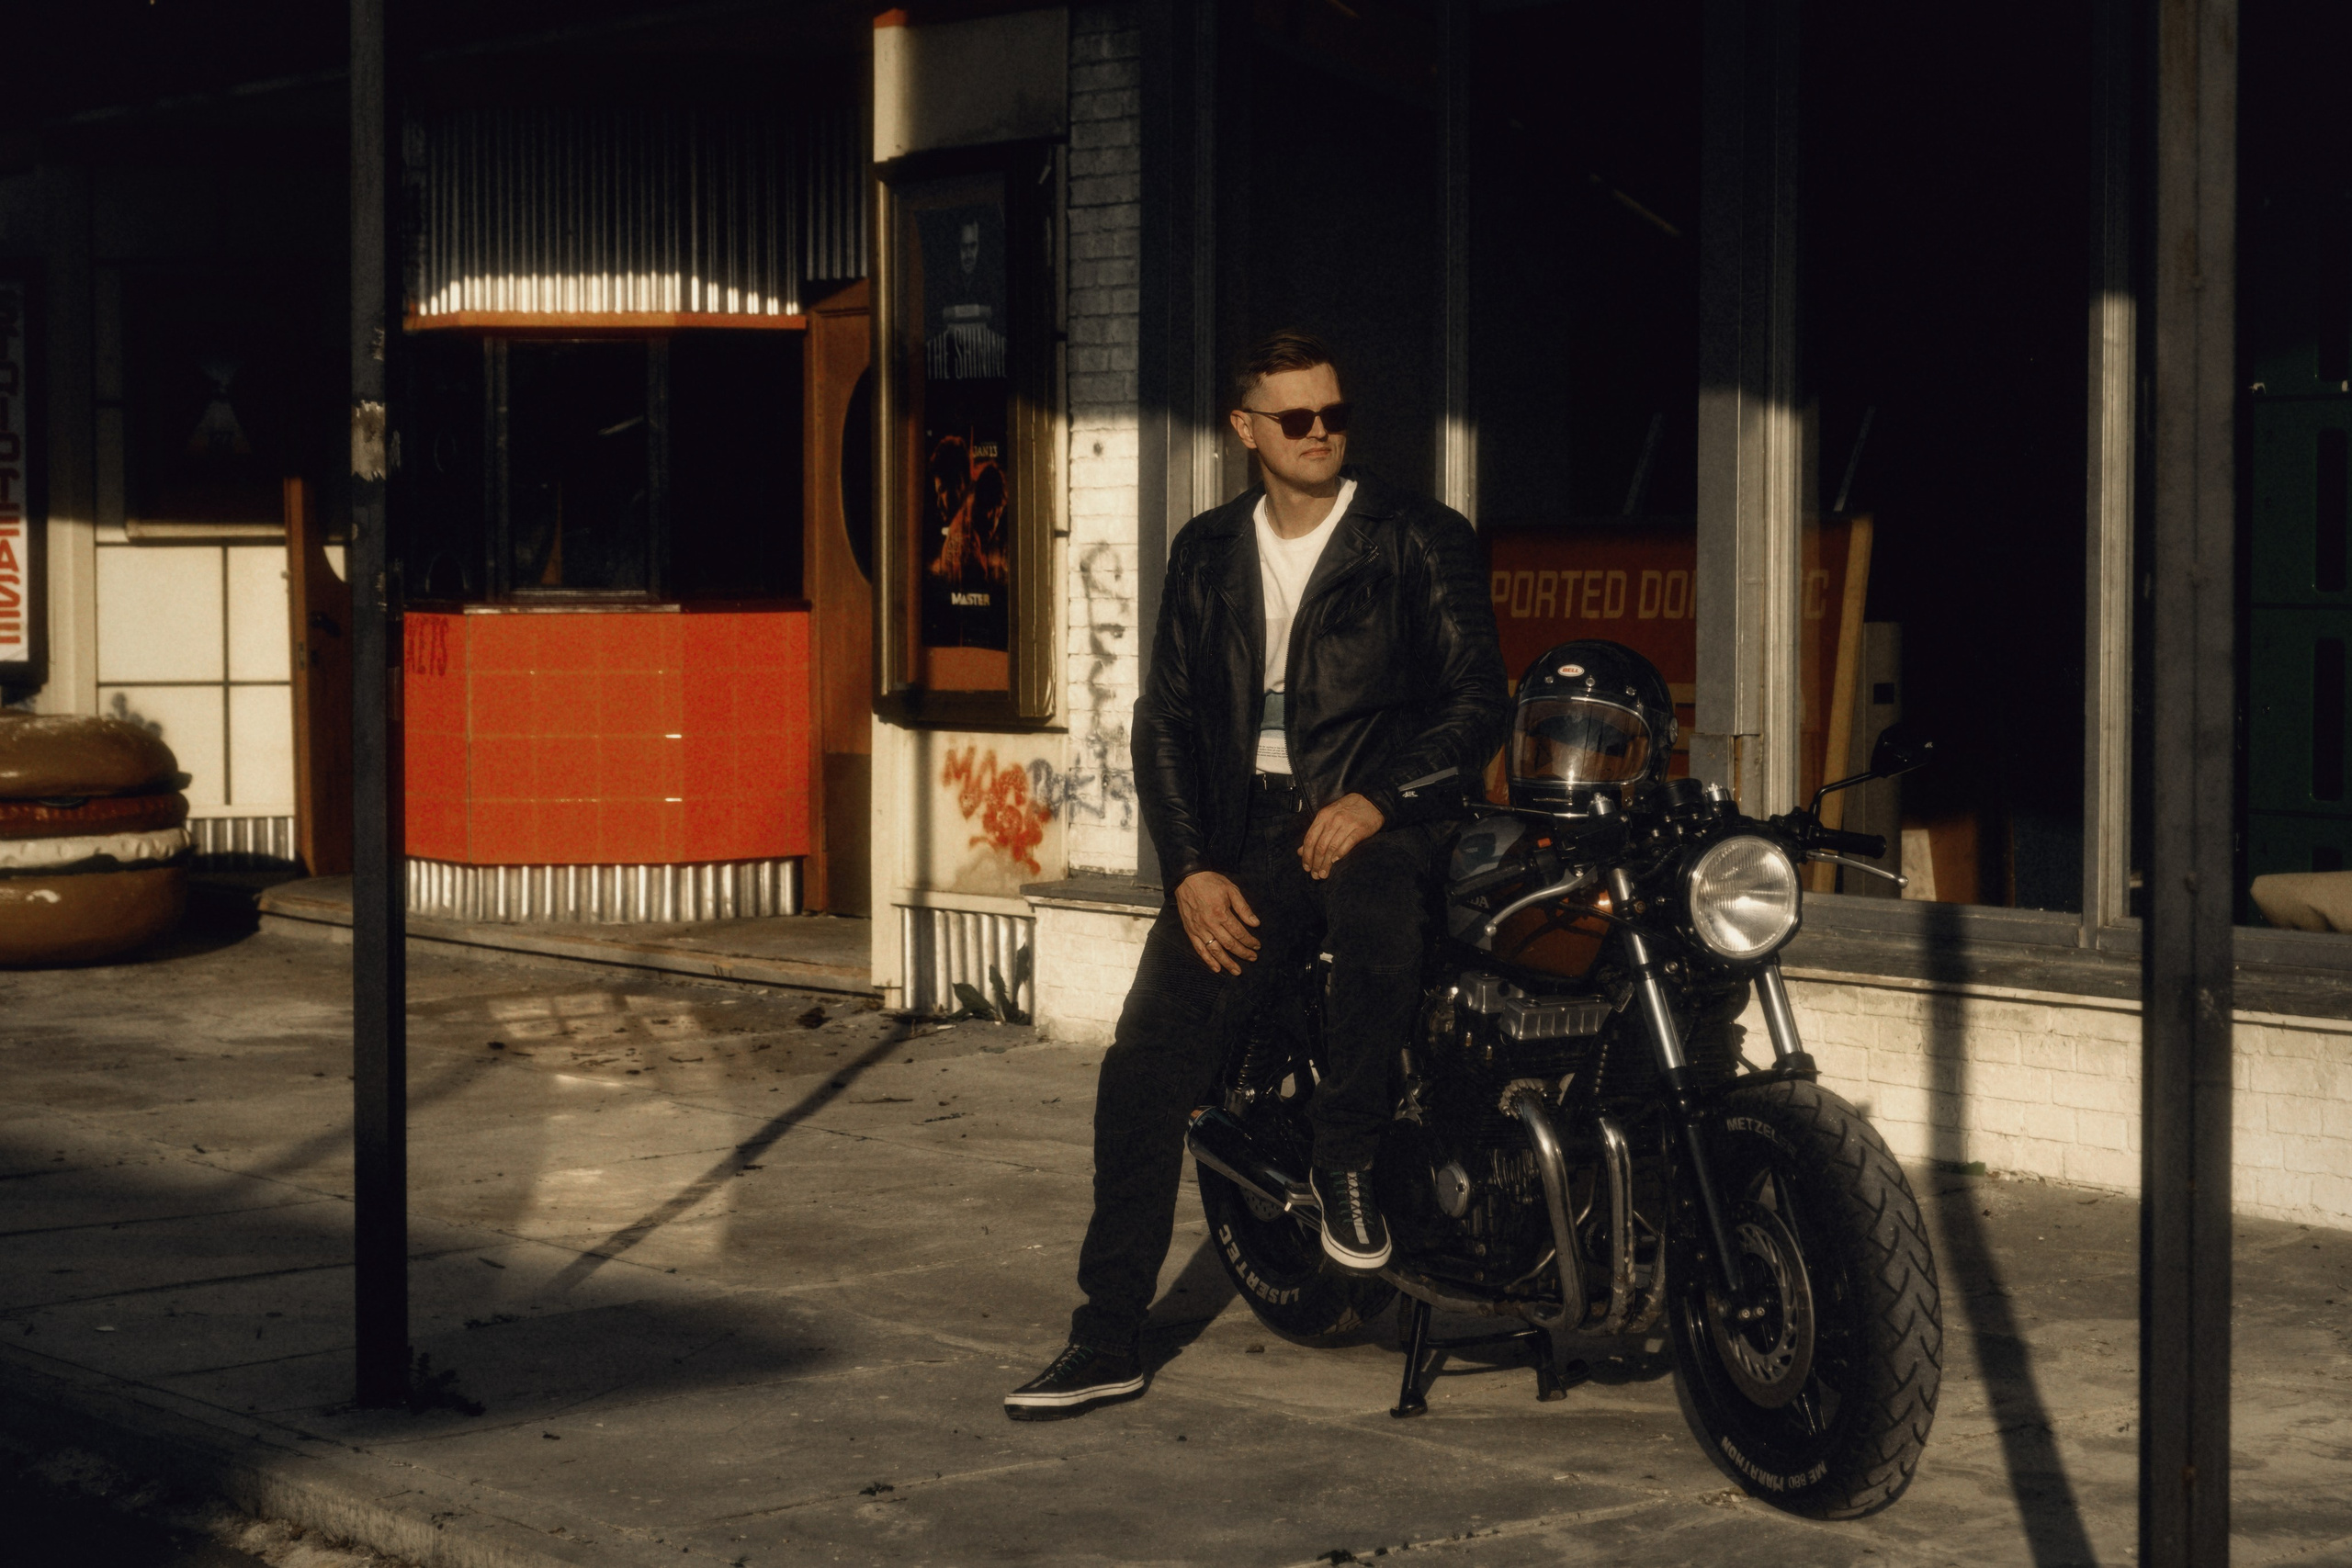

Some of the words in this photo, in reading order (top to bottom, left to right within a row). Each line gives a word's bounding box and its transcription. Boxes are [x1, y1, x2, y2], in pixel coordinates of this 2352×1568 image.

[925, 331, 951, 380] THE
[1490, 570, 1627, 618] PORTED
[1218, 1224, 1300, 1305] LASERTEC
[1721, 1436, 1784, 1492] MARATHON
[1788, 1472, 1807, 1489] 880
[1807, 1460, 1828, 1484] ME
